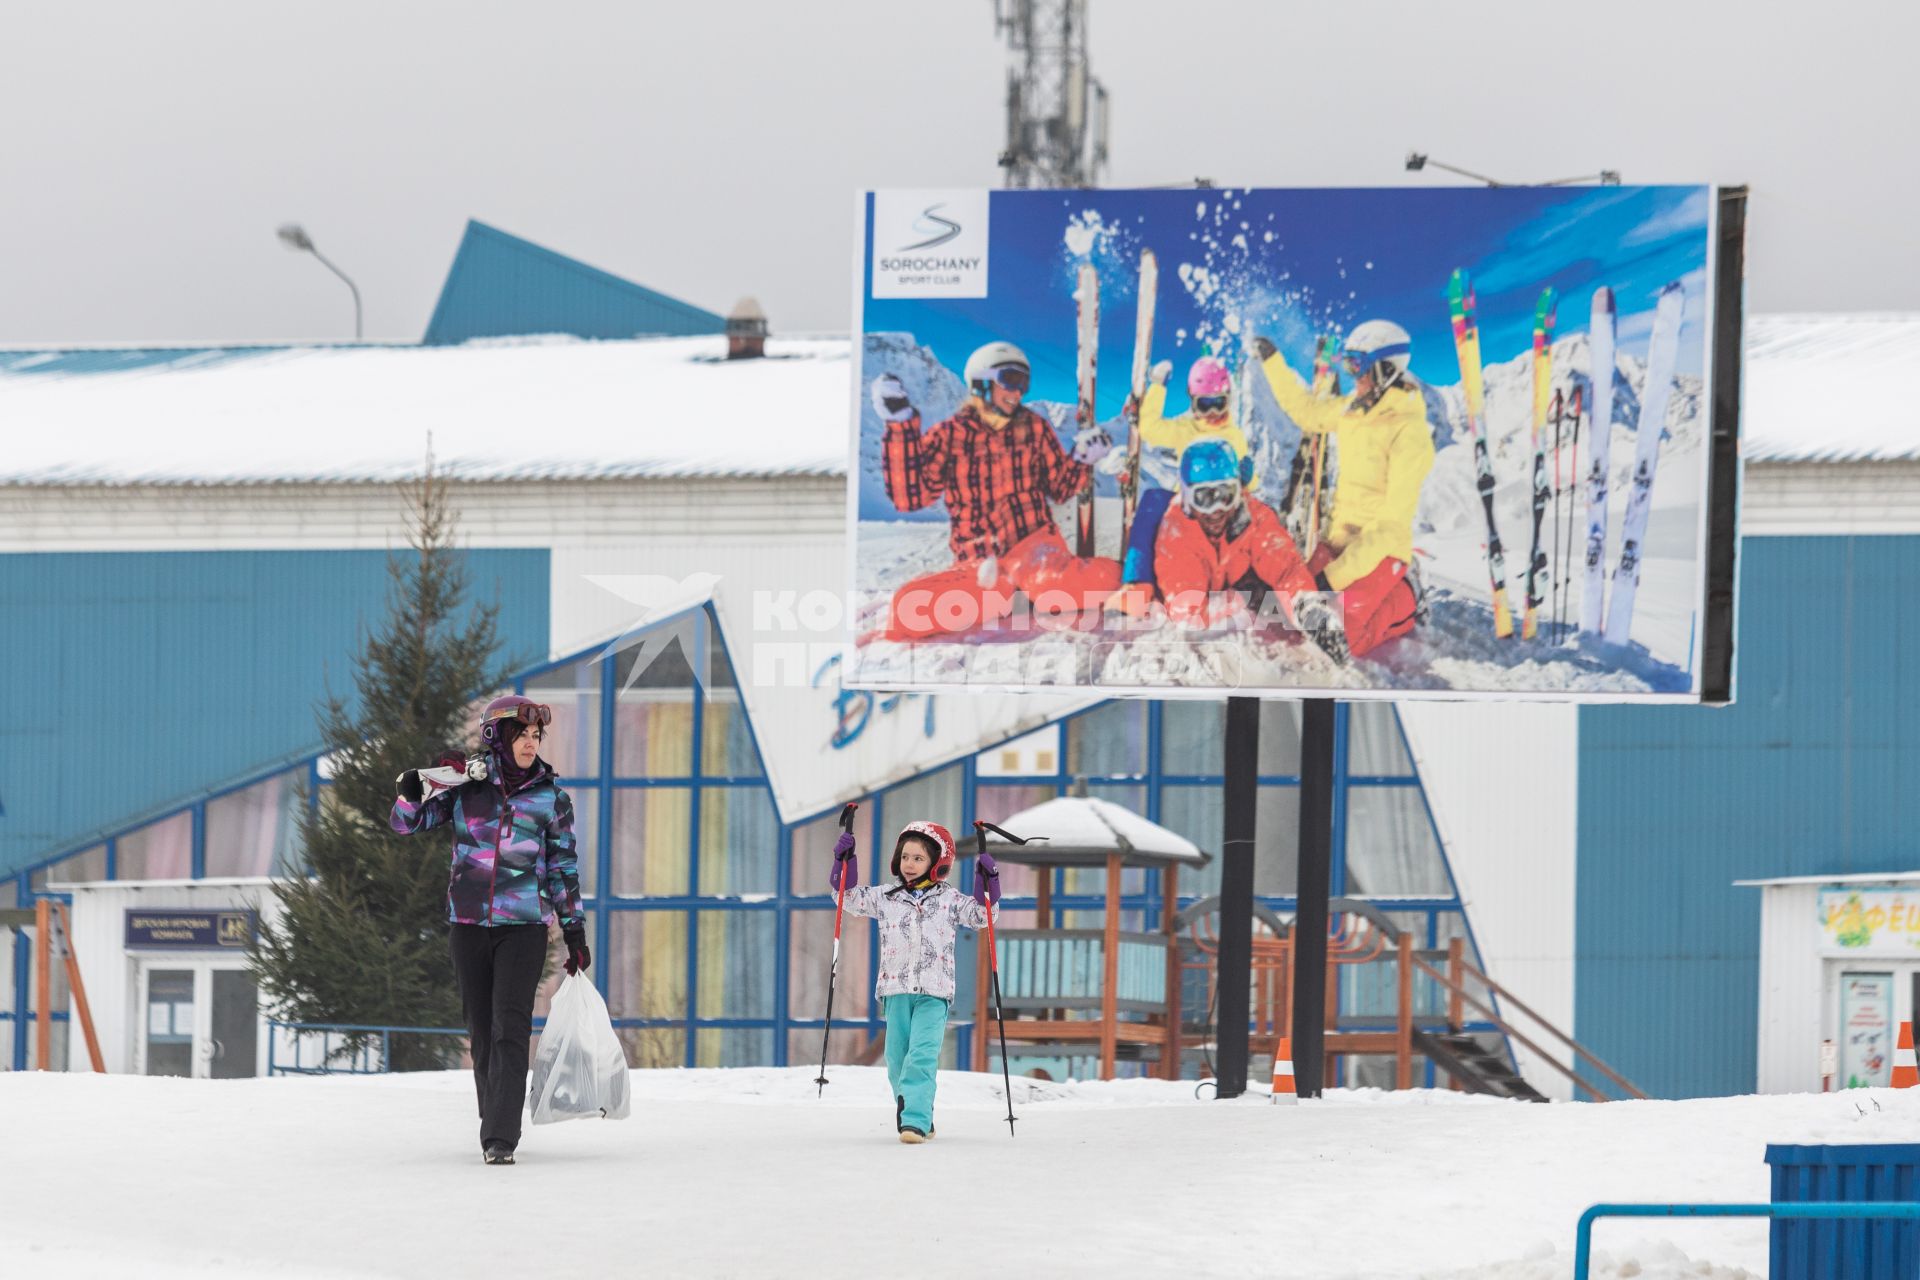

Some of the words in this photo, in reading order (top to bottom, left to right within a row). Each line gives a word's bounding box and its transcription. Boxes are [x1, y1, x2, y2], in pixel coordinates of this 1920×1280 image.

[880, 258, 980, 272] SOROCHANY
[899, 275, 932, 285] SPORT
[934, 275, 961, 285] CLUB
